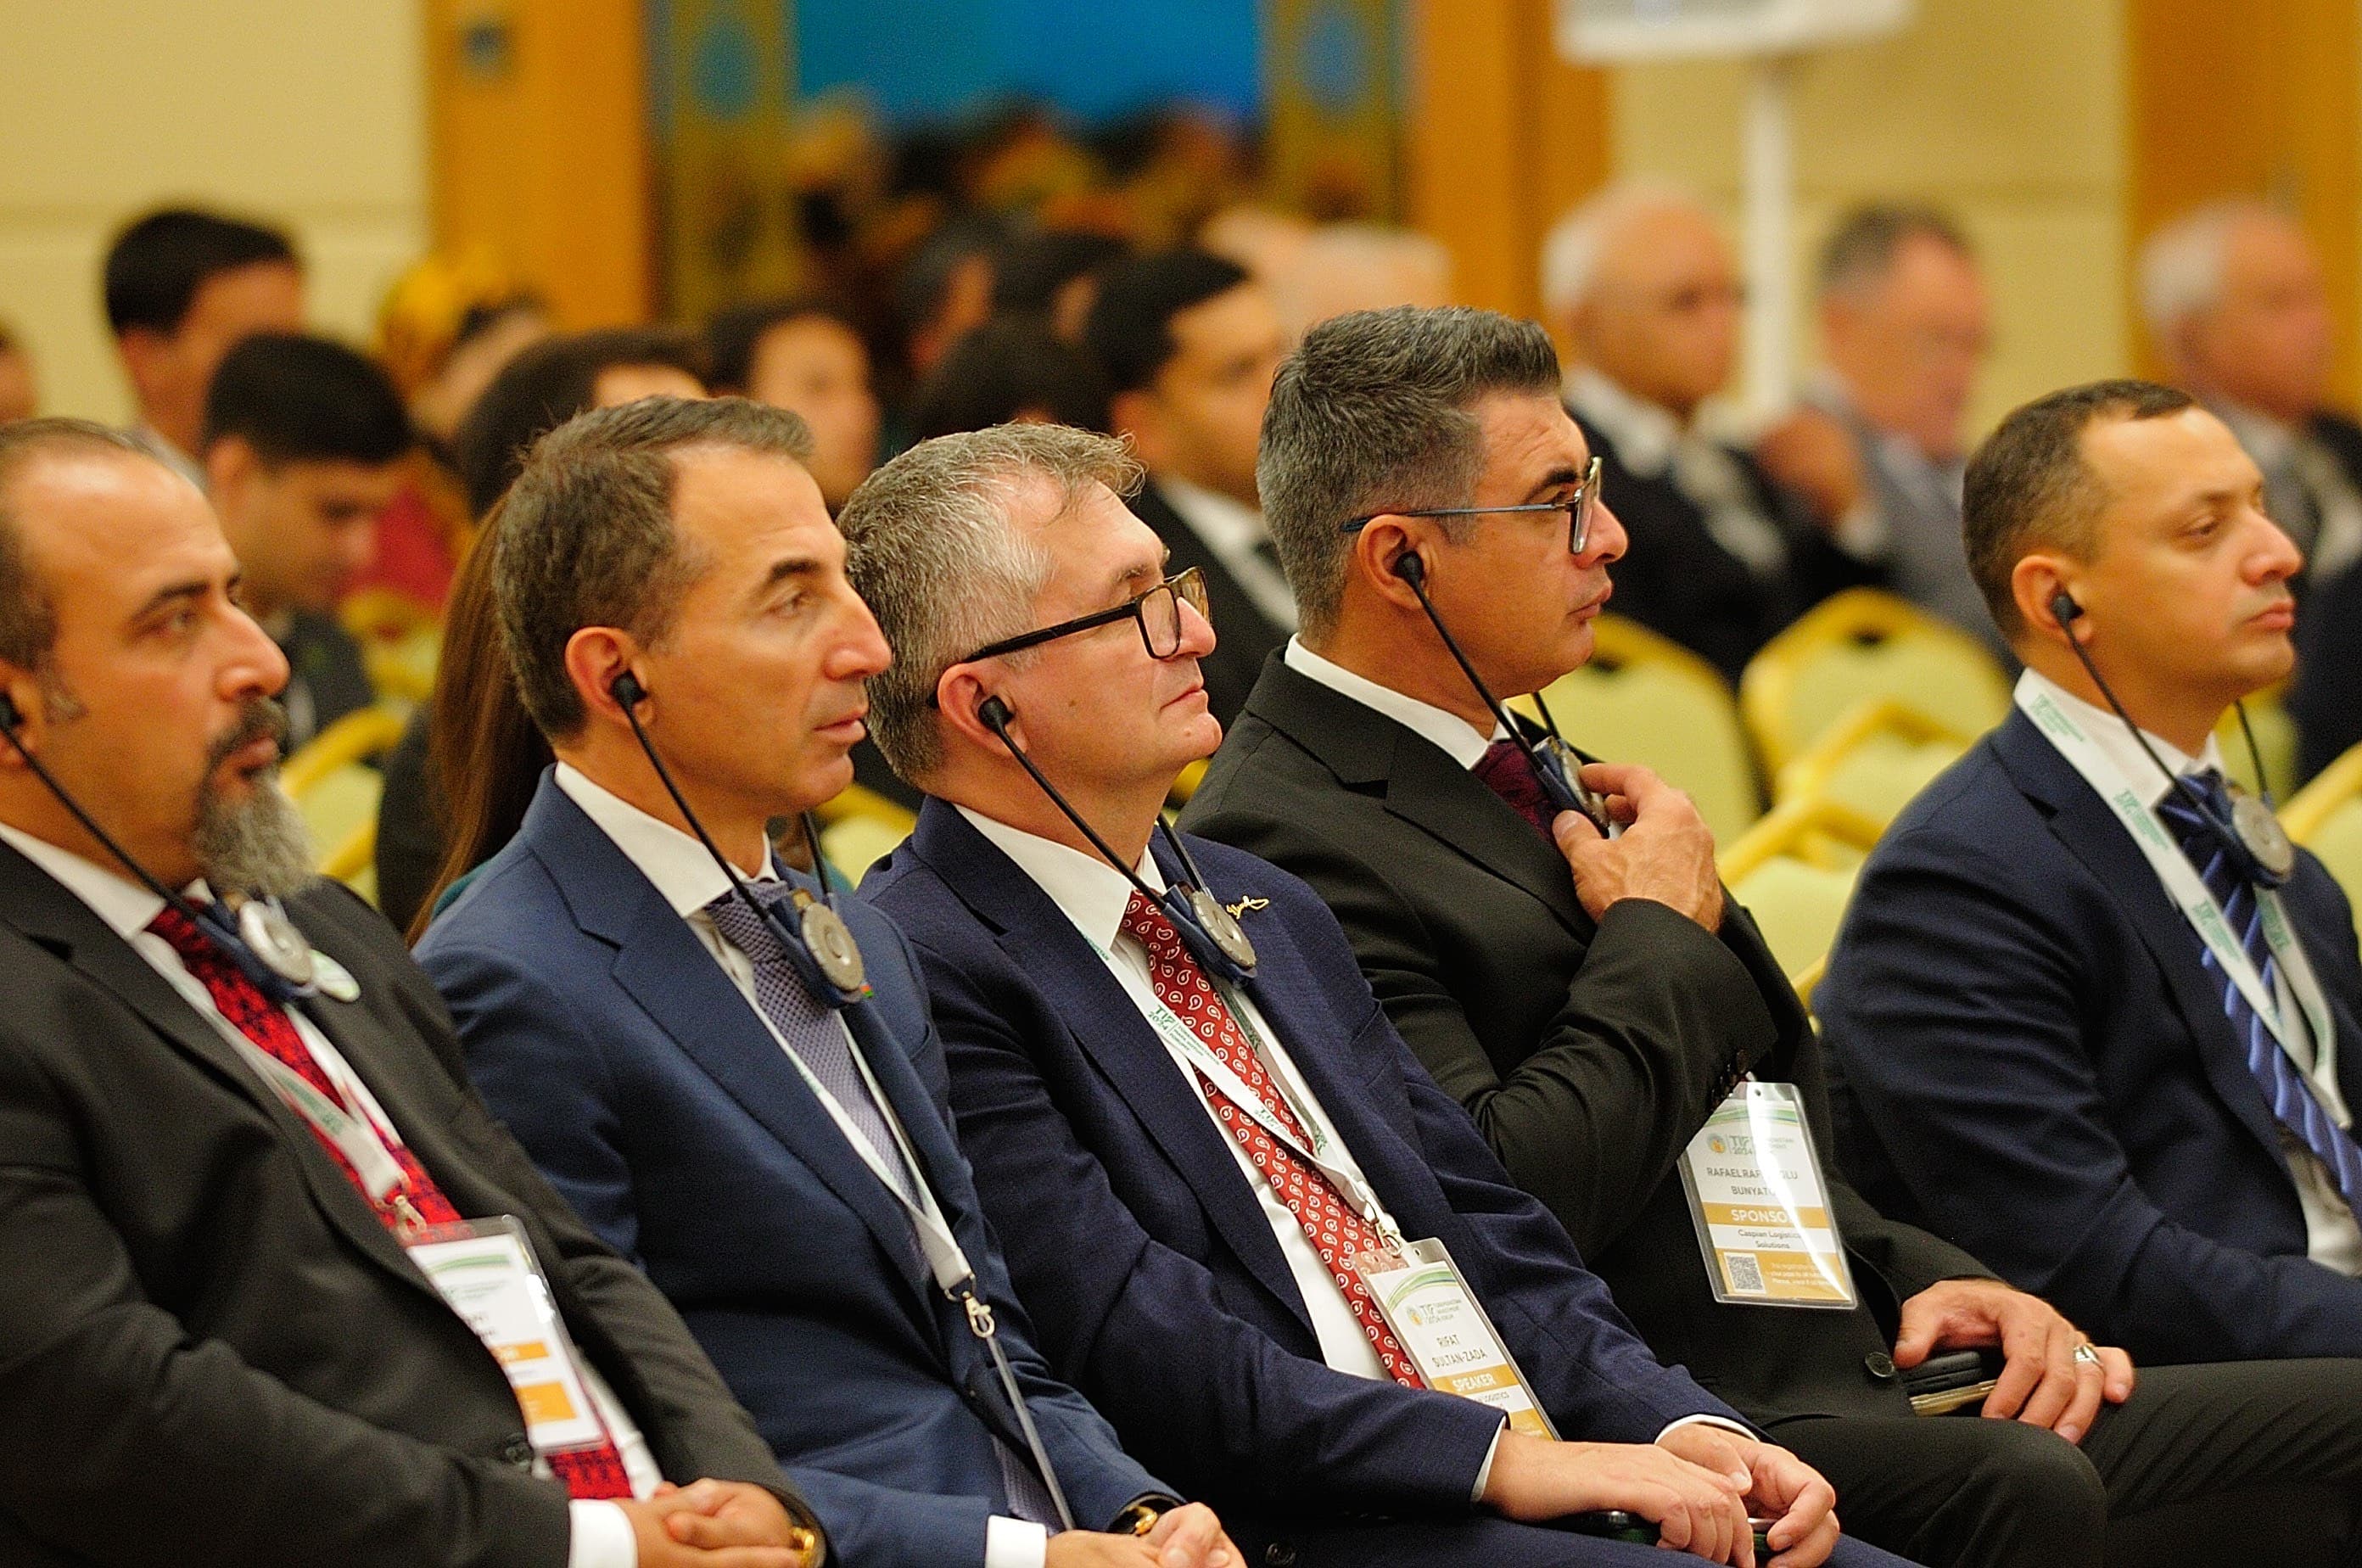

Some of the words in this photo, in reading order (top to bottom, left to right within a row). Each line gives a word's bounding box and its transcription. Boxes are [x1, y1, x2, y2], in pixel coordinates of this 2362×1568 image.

[1706, 1167, 1742, 1179] RAFAEL
[1731, 1209, 1788, 1224] SPONSO
[1738, 1229, 1768, 1238] Caspian
[1431, 1348, 1488, 1368] SULTAN-ZADA
[1452, 1373, 1497, 1392] SPEAKER
